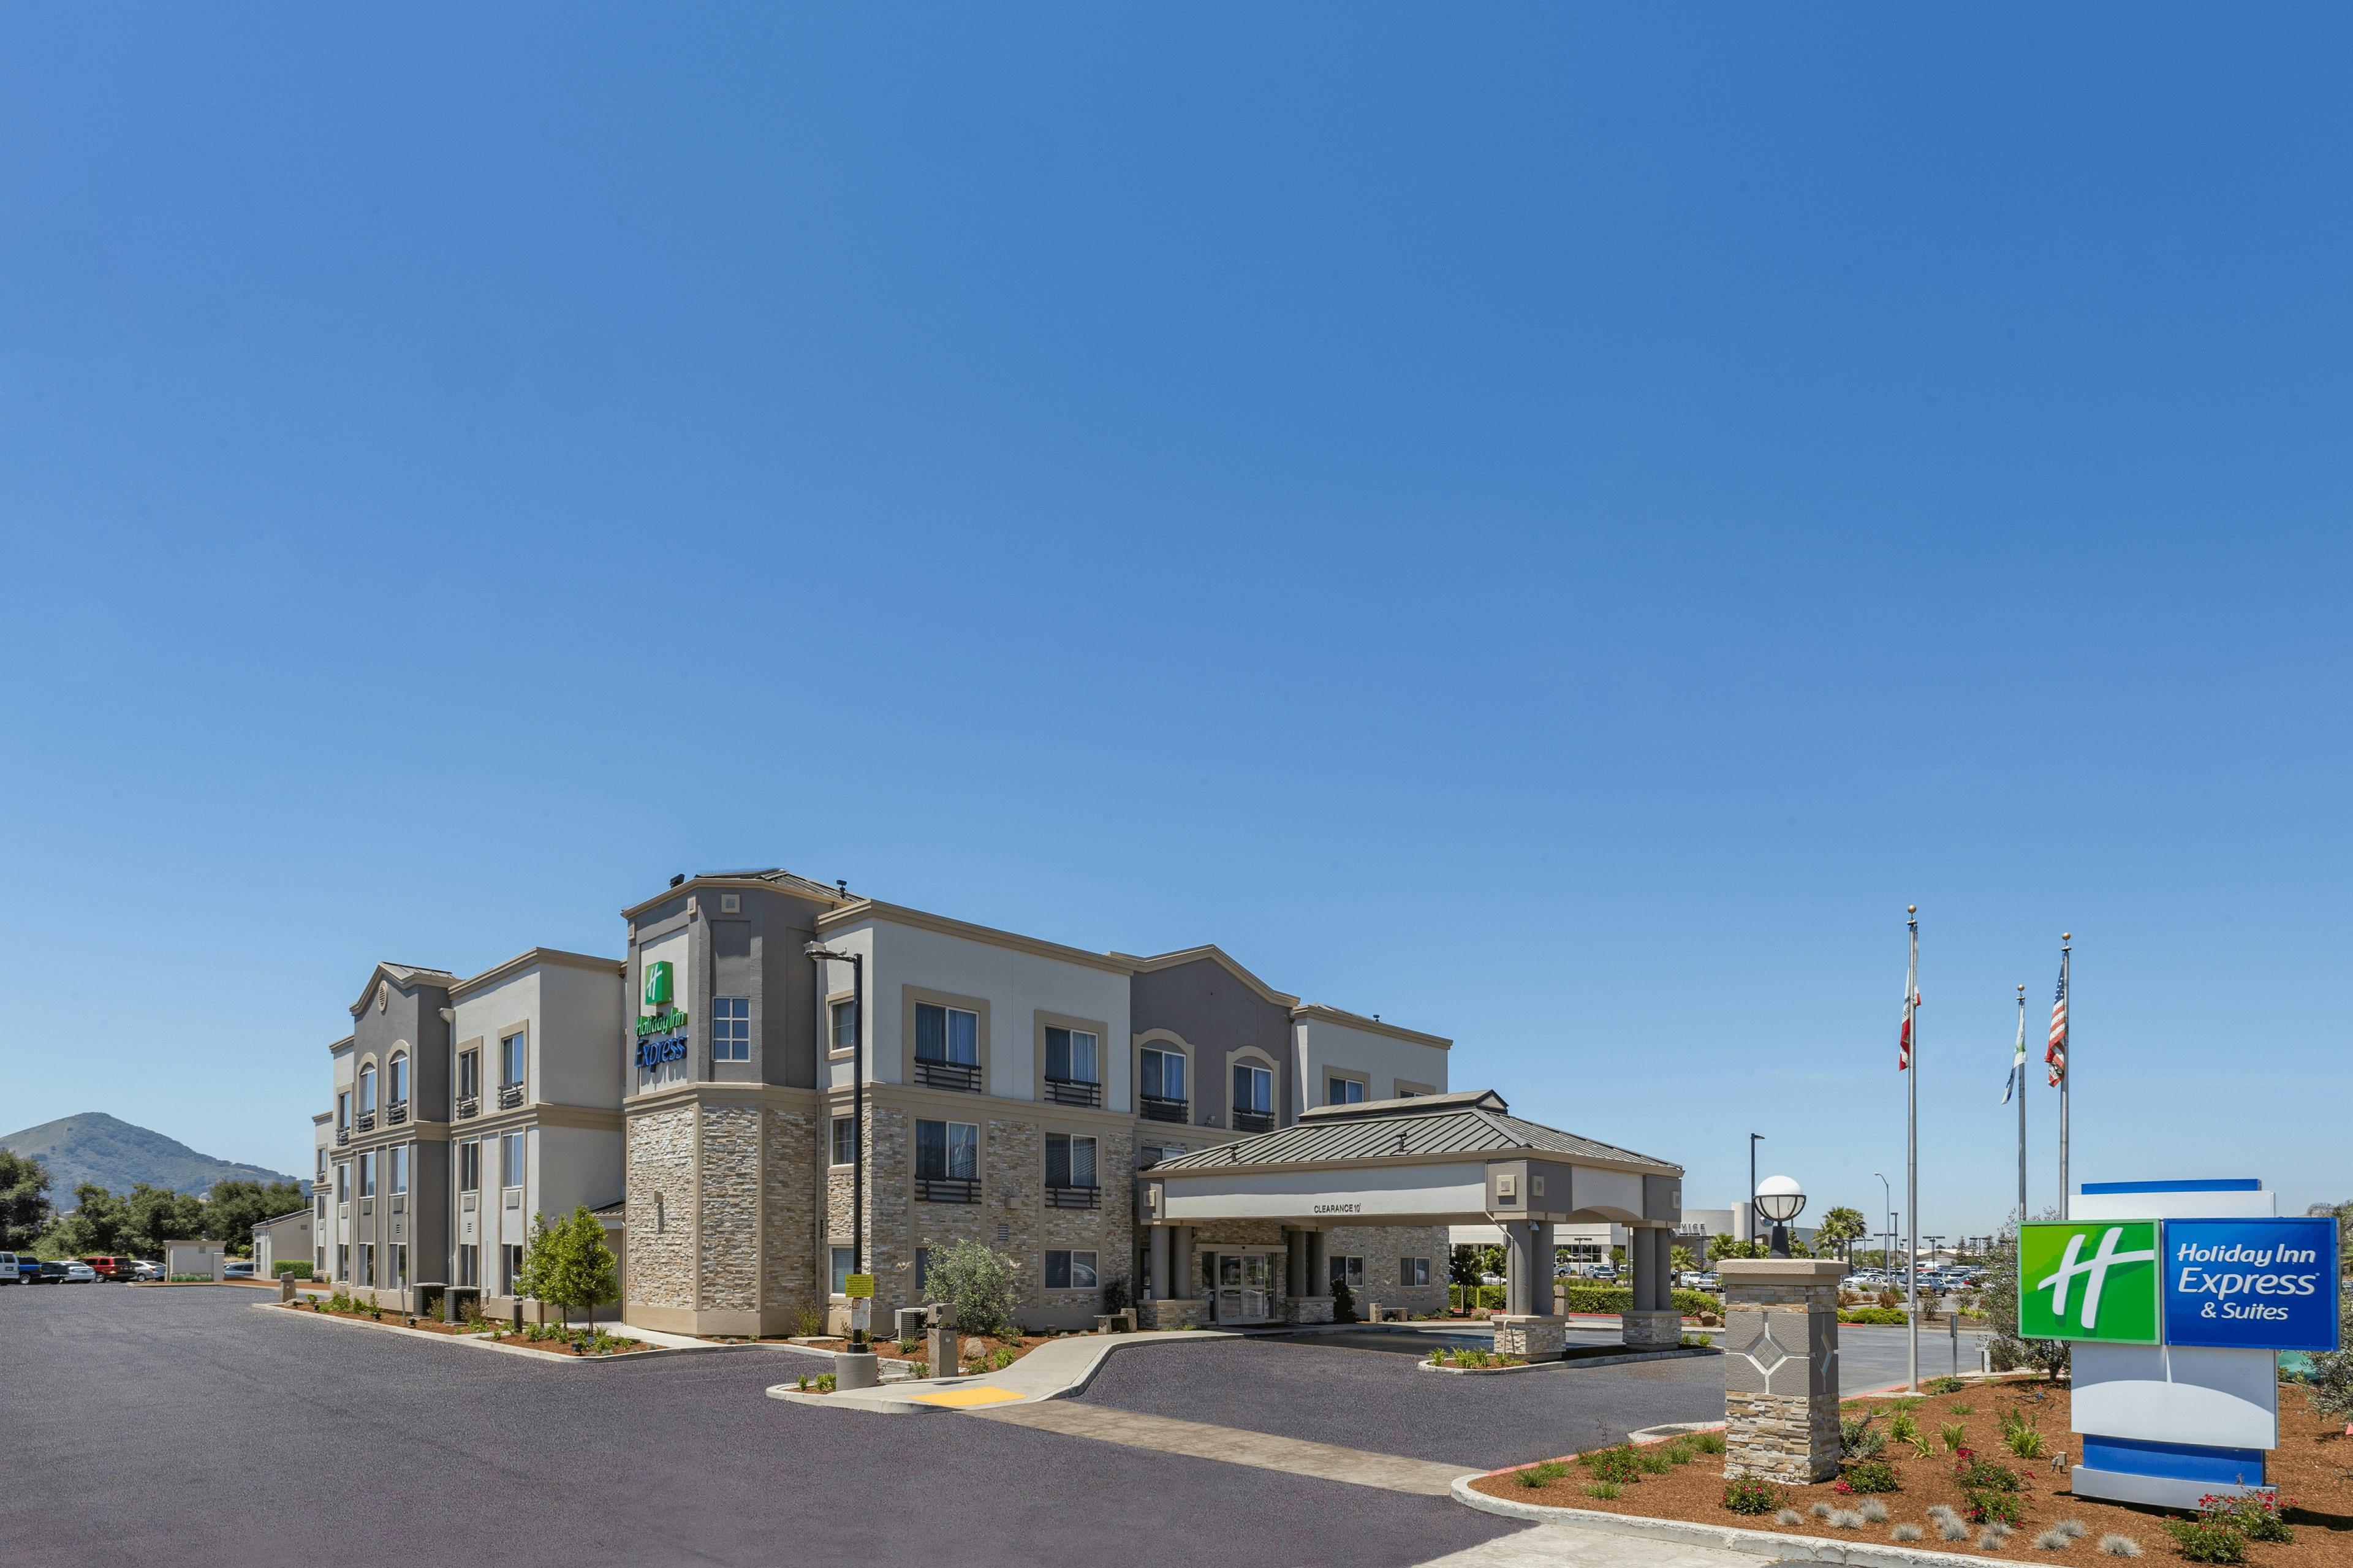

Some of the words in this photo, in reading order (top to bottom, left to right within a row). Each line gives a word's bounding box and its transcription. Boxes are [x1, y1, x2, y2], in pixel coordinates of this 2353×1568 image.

[635, 1013, 669, 1036] Holiday
[670, 1008, 685, 1028] Inn
[634, 1037, 686, 1072] Express
[1314, 1204, 1353, 1213] CLEARANCE
[2177, 1243, 2273, 1267] Holiday
[2275, 1243, 2316, 1263] Inn
[2178, 1267, 2316, 1301] Express
[2200, 1301, 2217, 1318] &
[2221, 1302, 2289, 1320] Suites
